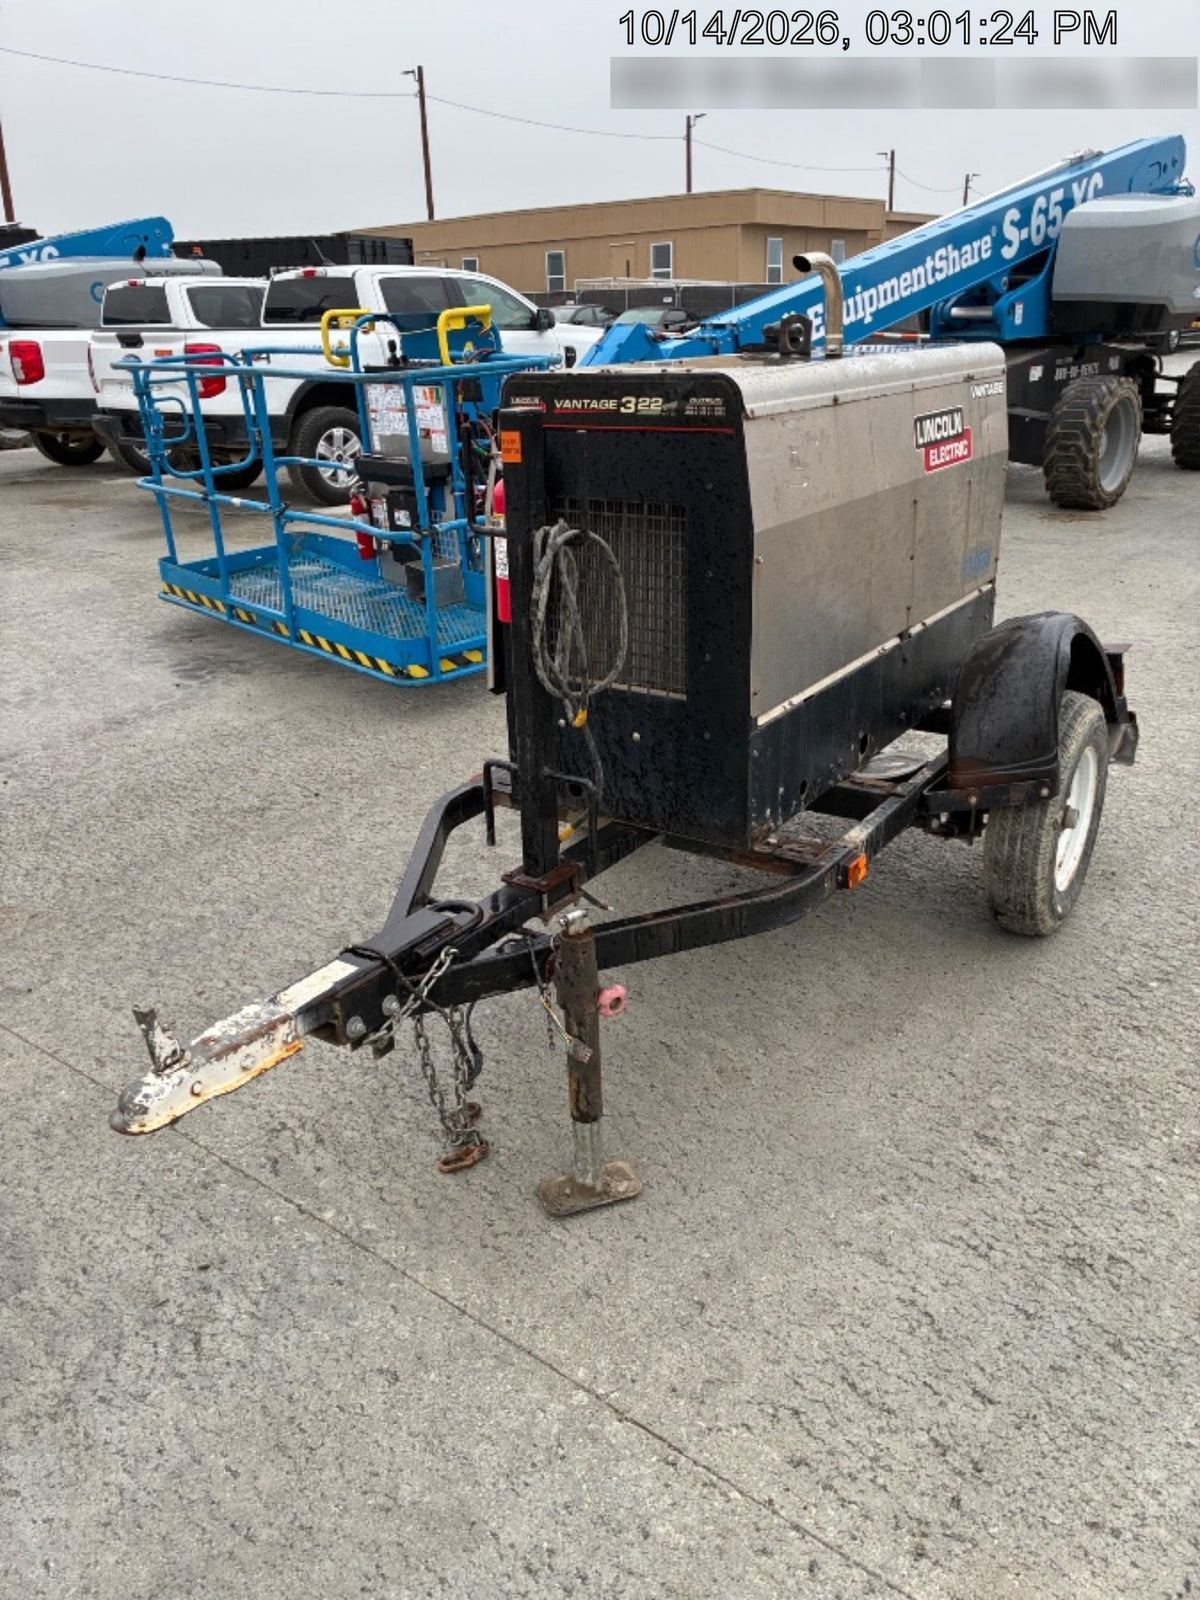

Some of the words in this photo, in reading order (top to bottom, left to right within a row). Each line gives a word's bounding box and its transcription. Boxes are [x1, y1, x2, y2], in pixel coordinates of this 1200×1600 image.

[1001, 187, 1065, 260] S-65
[810, 233, 992, 343] EuipmentShare
[554, 398, 618, 410] VANTAGE
[620, 395, 663, 413] 322
[970, 382, 1004, 399] VANTAGE
[916, 410, 963, 445] LINCOLN
[929, 440, 969, 467] ELECTRIC
